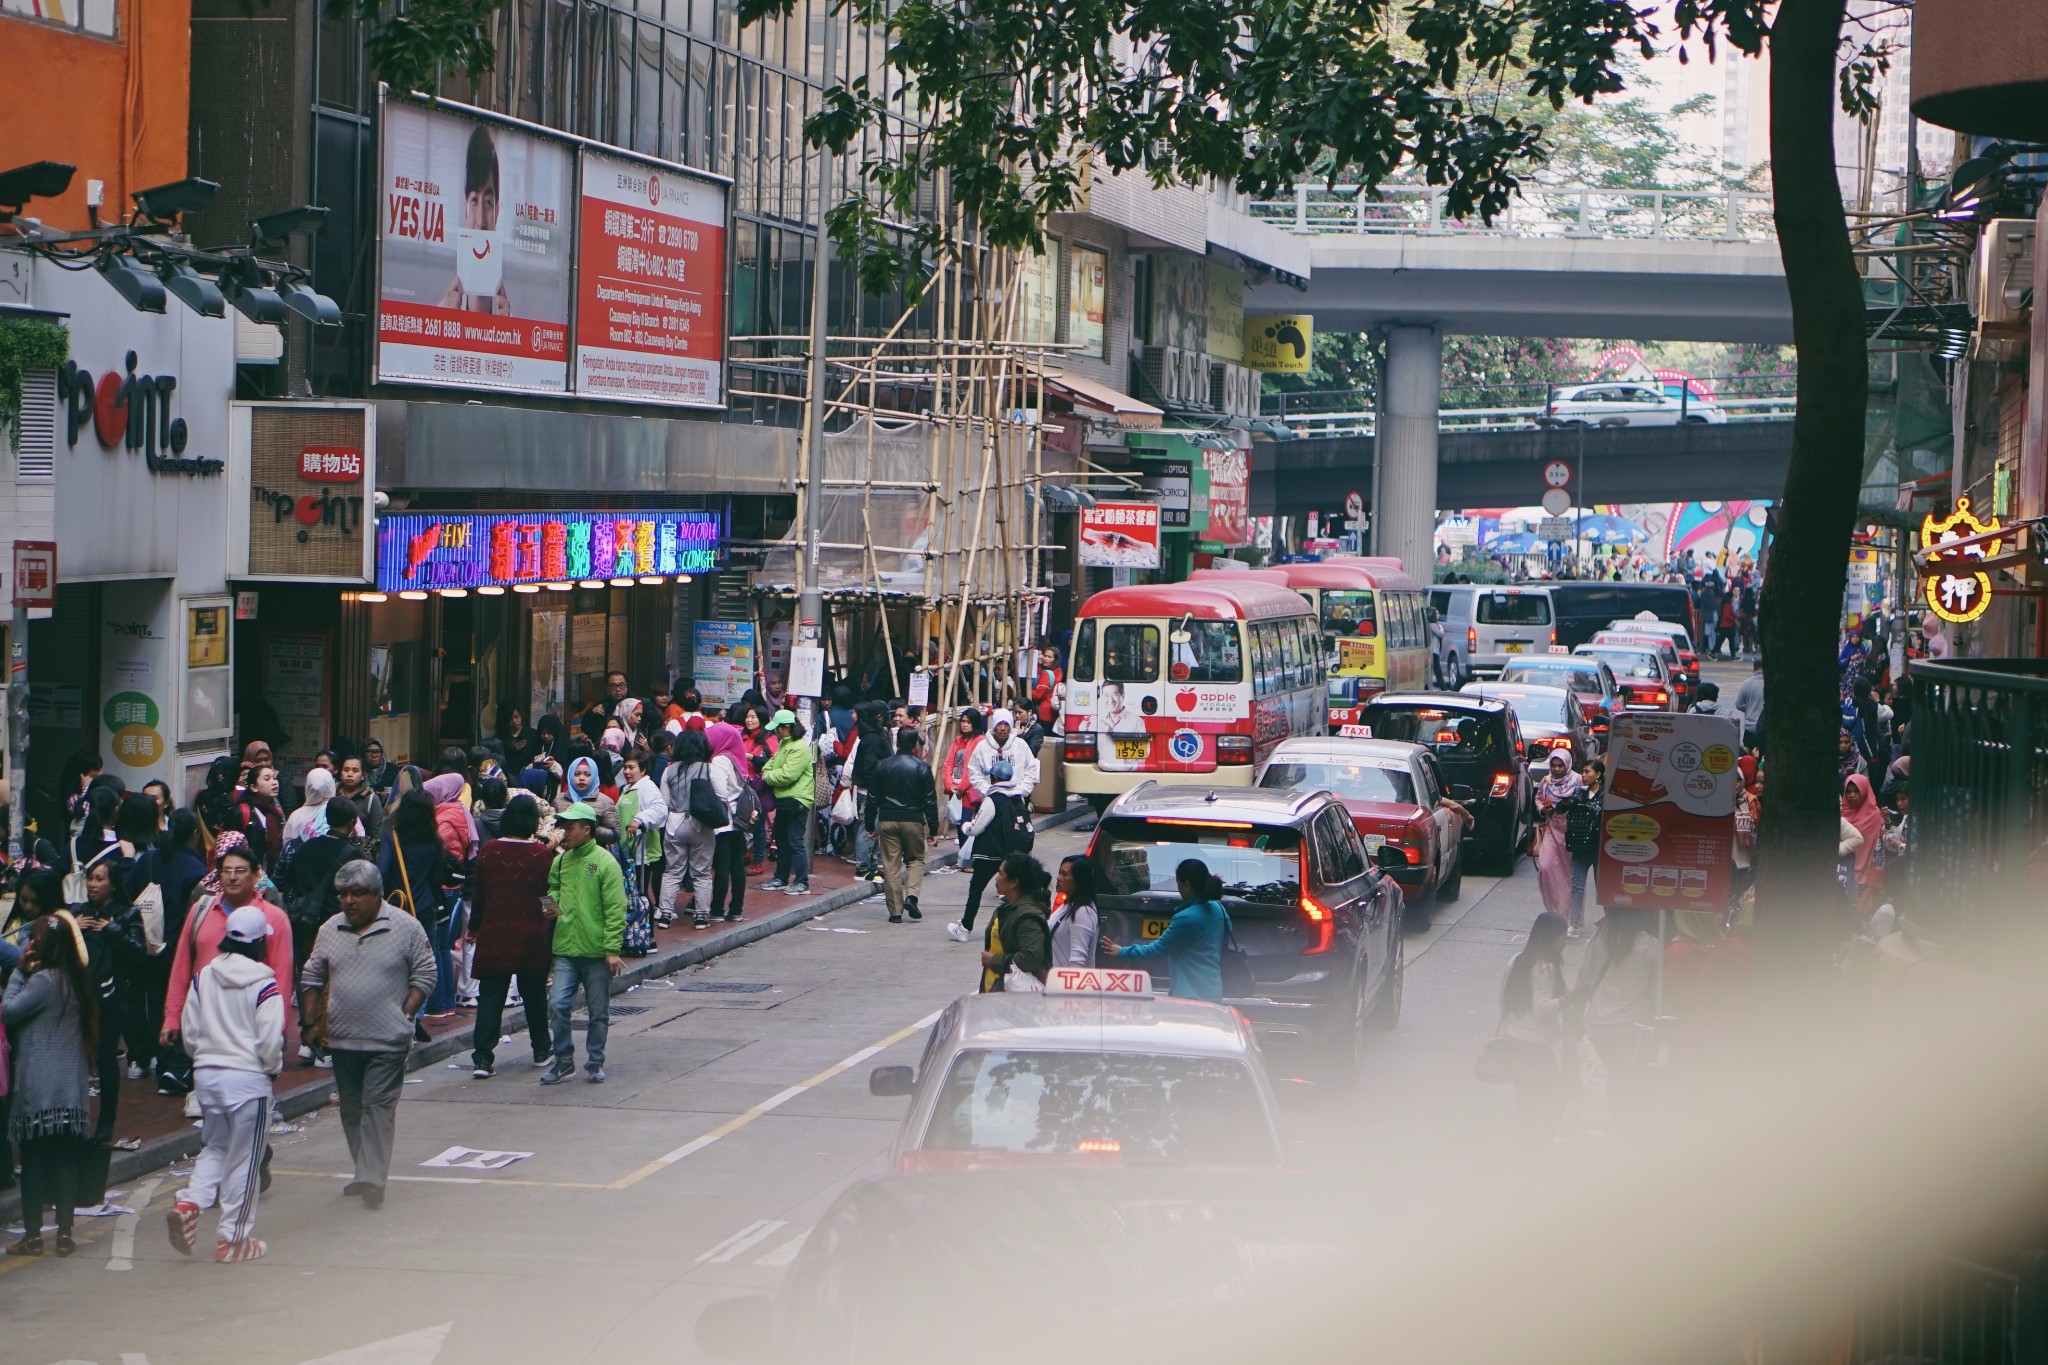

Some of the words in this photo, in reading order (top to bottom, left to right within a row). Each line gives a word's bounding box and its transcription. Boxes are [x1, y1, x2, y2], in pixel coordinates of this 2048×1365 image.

[604, 209, 655, 245] 銅鑼灣第二分行
[609, 307, 632, 327] Causeway
[632, 310, 641, 328] Bay
[645, 313, 659, 327] Branch
[425, 320, 441, 336] 2681
[443, 321, 461, 339] 8888
[464, 326, 521, 346] www.uaf.com.hk
[610, 327, 623, 342] Room
[644, 332, 665, 350] Causeway
[666, 334, 674, 351] Bay
[303, 453, 361, 475] 購物站
[1168, 465, 1188, 474] OPTICAL
[1163, 511, 1186, 523] 眼鏡
[443, 523, 472, 548] FIVE
[681, 522, 717, 540] NOODLE
[682, 550, 716, 570] CONGEE
[1941, 574, 1977, 611] 押
[1201, 692, 1237, 702] apple
[115, 702, 147, 723] 銅鑼
[1344, 726, 1369, 736] TAXI
[1640, 726, 1674, 734] one2free
[122, 735, 153, 756] 廣場
[1118, 749, 1145, 757] 1579
[1125, 741, 1138, 749] LN
[1058, 971, 1143, 993] TAXI
